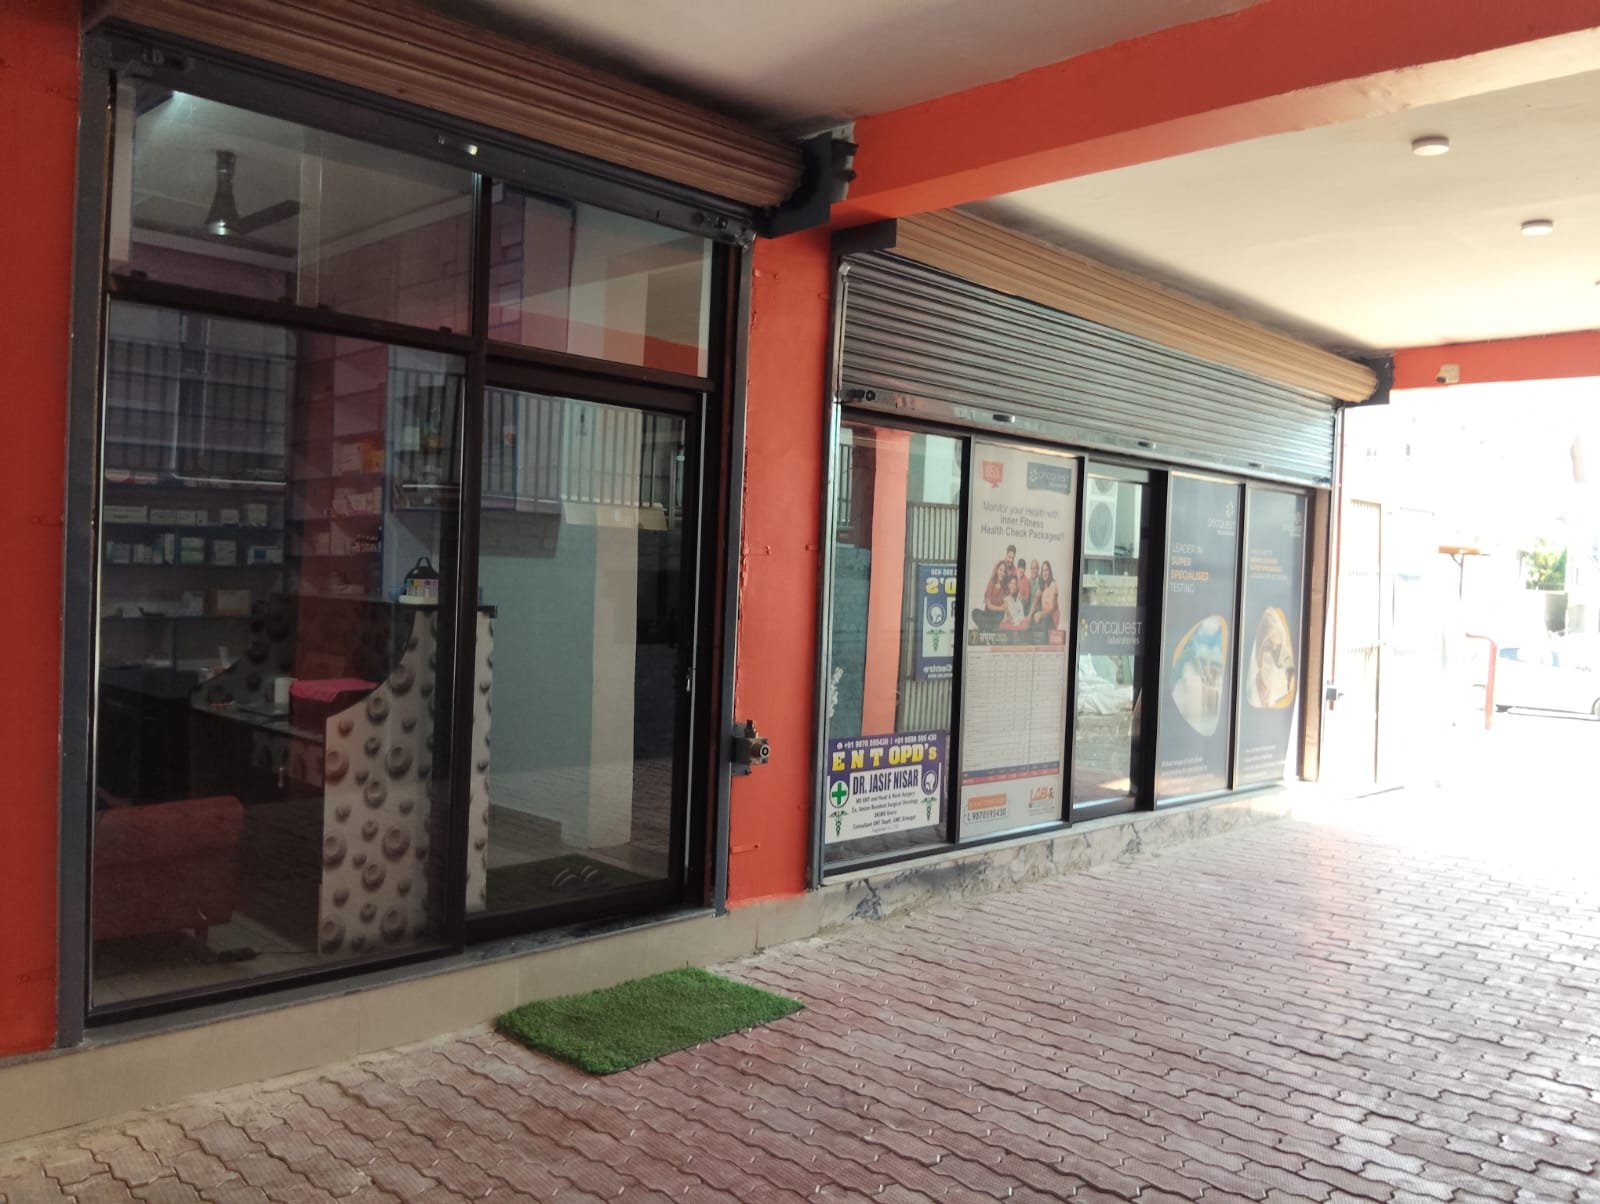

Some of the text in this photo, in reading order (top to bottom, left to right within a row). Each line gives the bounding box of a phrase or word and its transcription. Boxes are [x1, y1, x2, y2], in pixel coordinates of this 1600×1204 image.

[983, 500, 1008, 513] Monitor
[1010, 505, 1024, 516] your
[1025, 506, 1045, 518] Health
[1000, 514, 1044, 529] Inner Fitness
[981, 523, 1004, 535] Health
[1006, 527, 1027, 538] Check
[1171, 556, 1191, 567] SUPER
[852, 769, 918, 795] DR. JASIF NISAR
